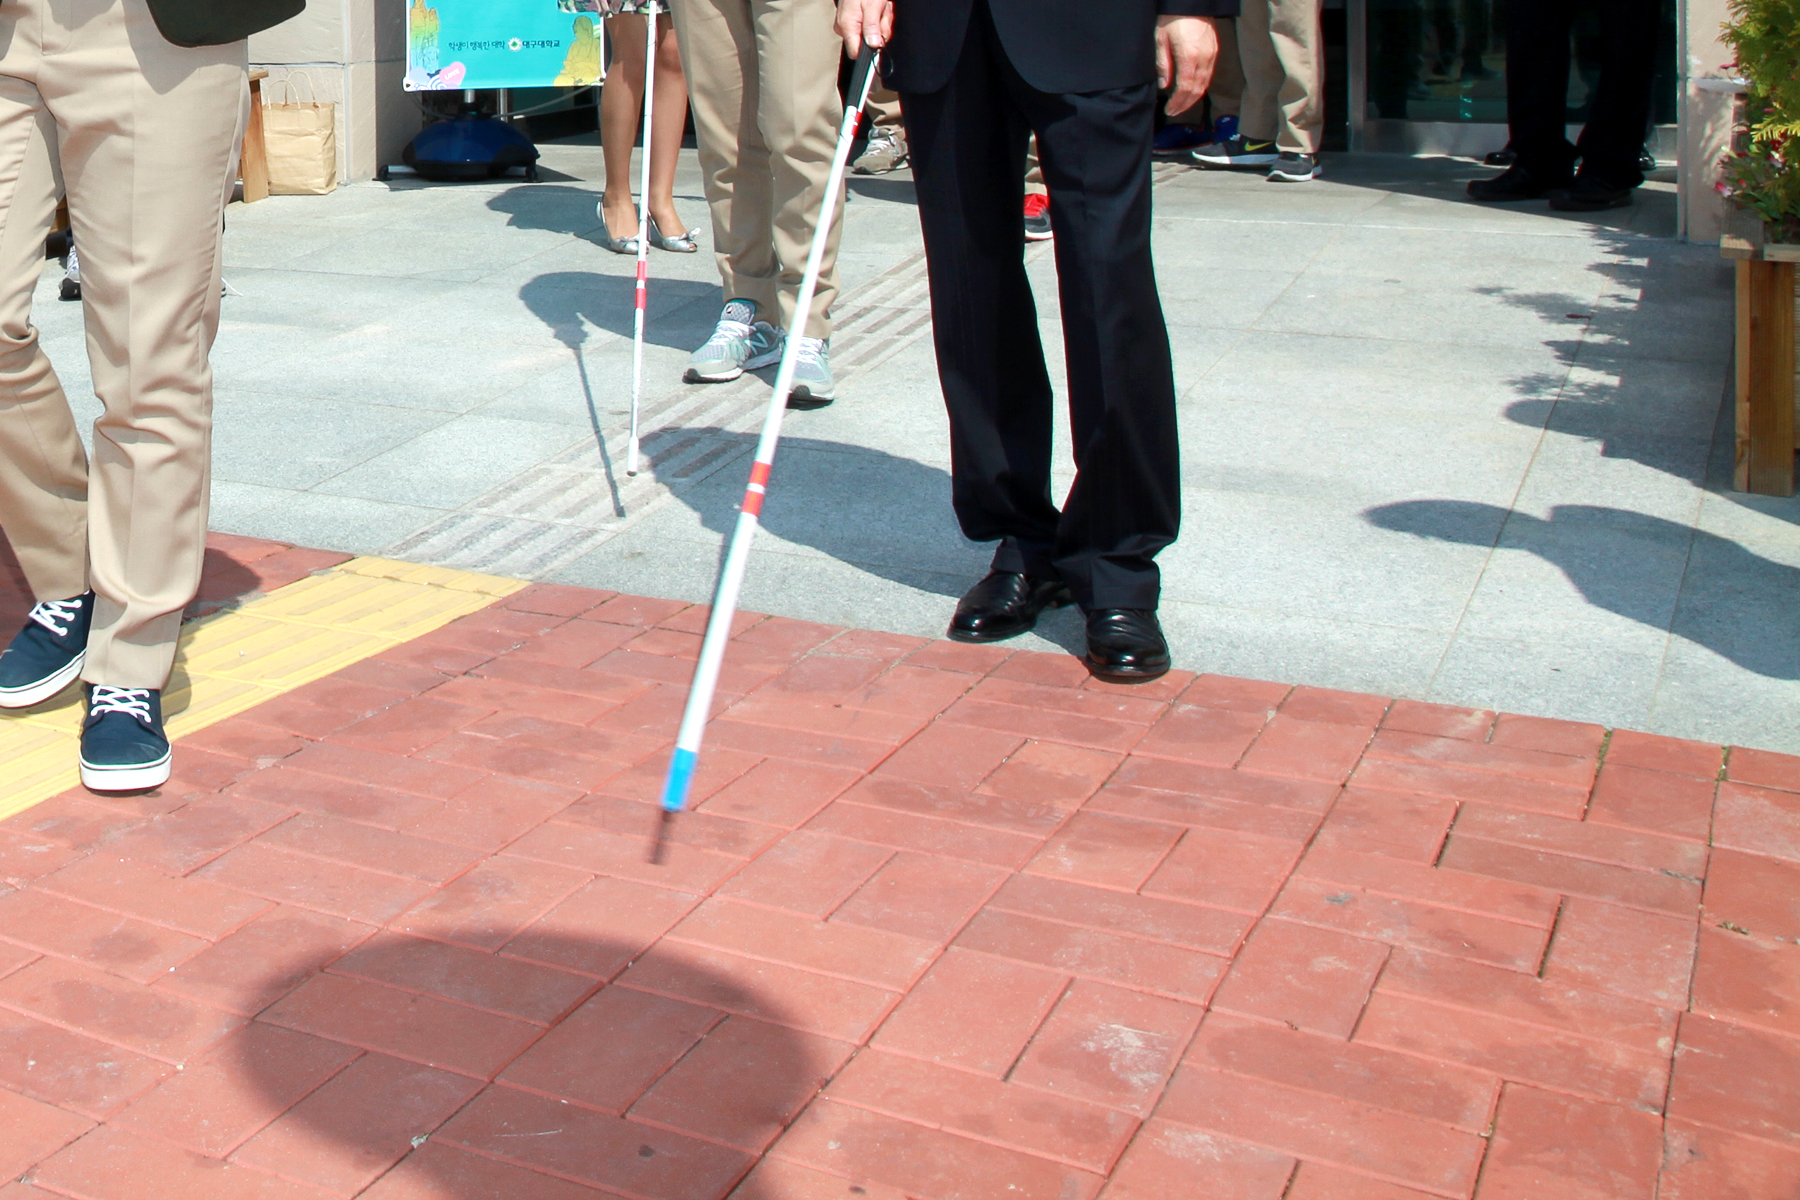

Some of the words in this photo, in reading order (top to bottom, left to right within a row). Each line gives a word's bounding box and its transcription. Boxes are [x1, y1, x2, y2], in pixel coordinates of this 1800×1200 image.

[448, 41, 468, 51] 학생이
[469, 41, 490, 51] 행복한
[491, 40, 505, 50] 대학
[522, 39, 560, 49] 대구대학교
[444, 67, 461, 80] LOVE
